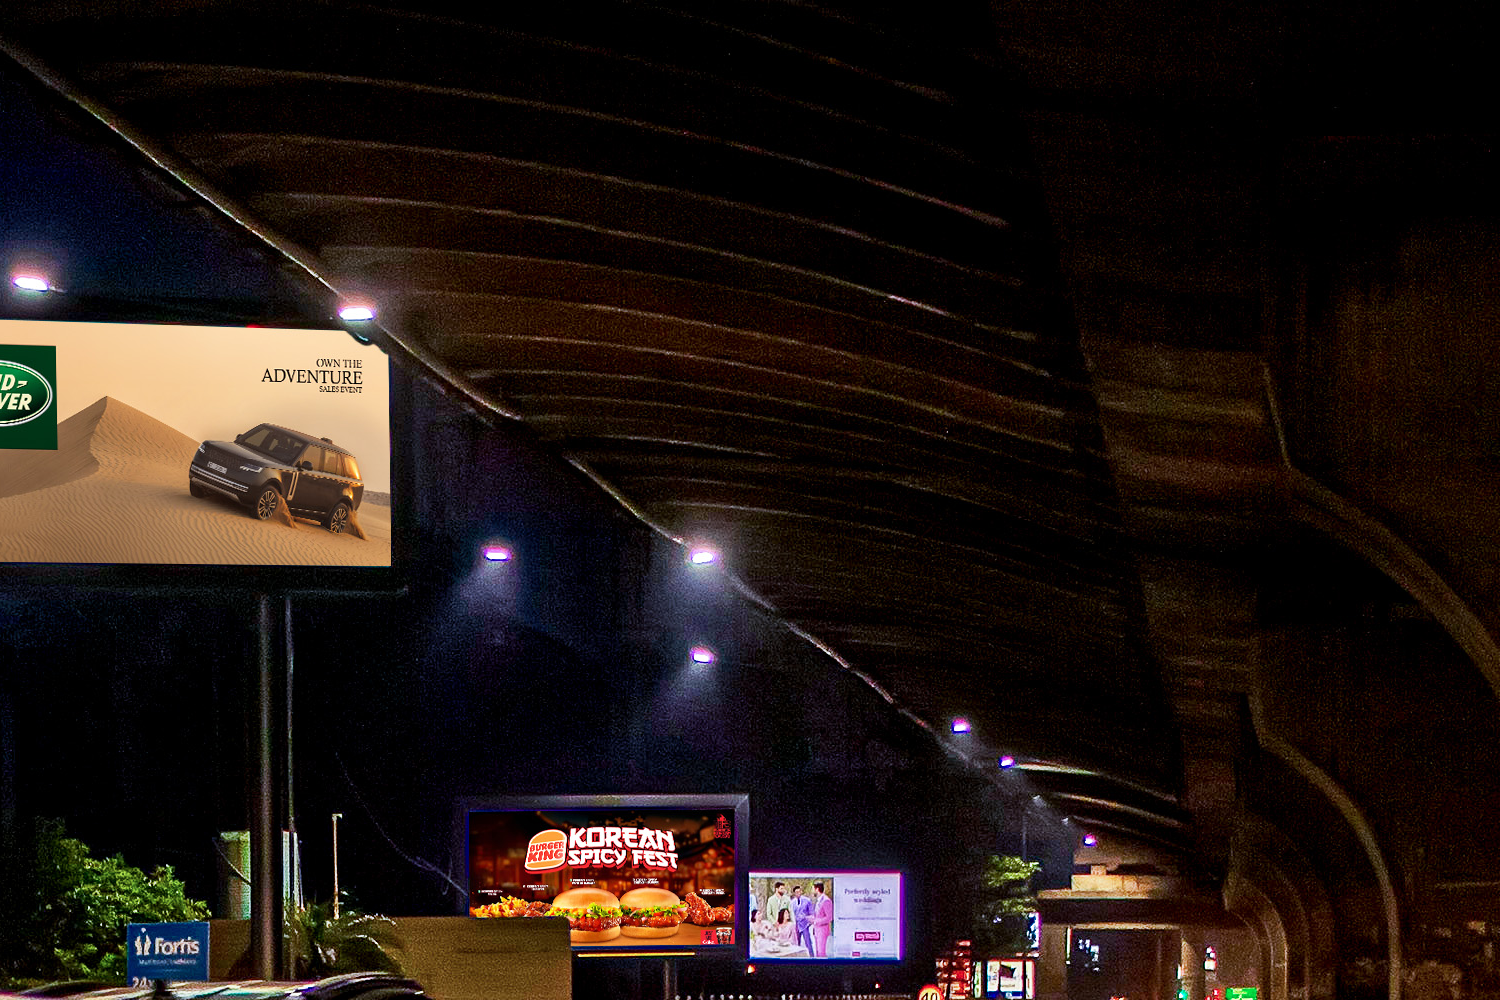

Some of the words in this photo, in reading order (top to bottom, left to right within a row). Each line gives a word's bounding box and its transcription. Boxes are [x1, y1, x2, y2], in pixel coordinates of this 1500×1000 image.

[316, 358, 341, 368] OWN
[342, 359, 363, 369] THE
[261, 368, 363, 385] ADVENTURE
[319, 385, 339, 393] SALES
[340, 386, 363, 394] EVENT
[529, 841, 565, 852] BURGER
[569, 826, 676, 851] KOREAN
[527, 848, 564, 863] KING
[567, 849, 626, 868] SPICY
[631, 850, 678, 870] FEST
[154, 936, 200, 956] Fortis
